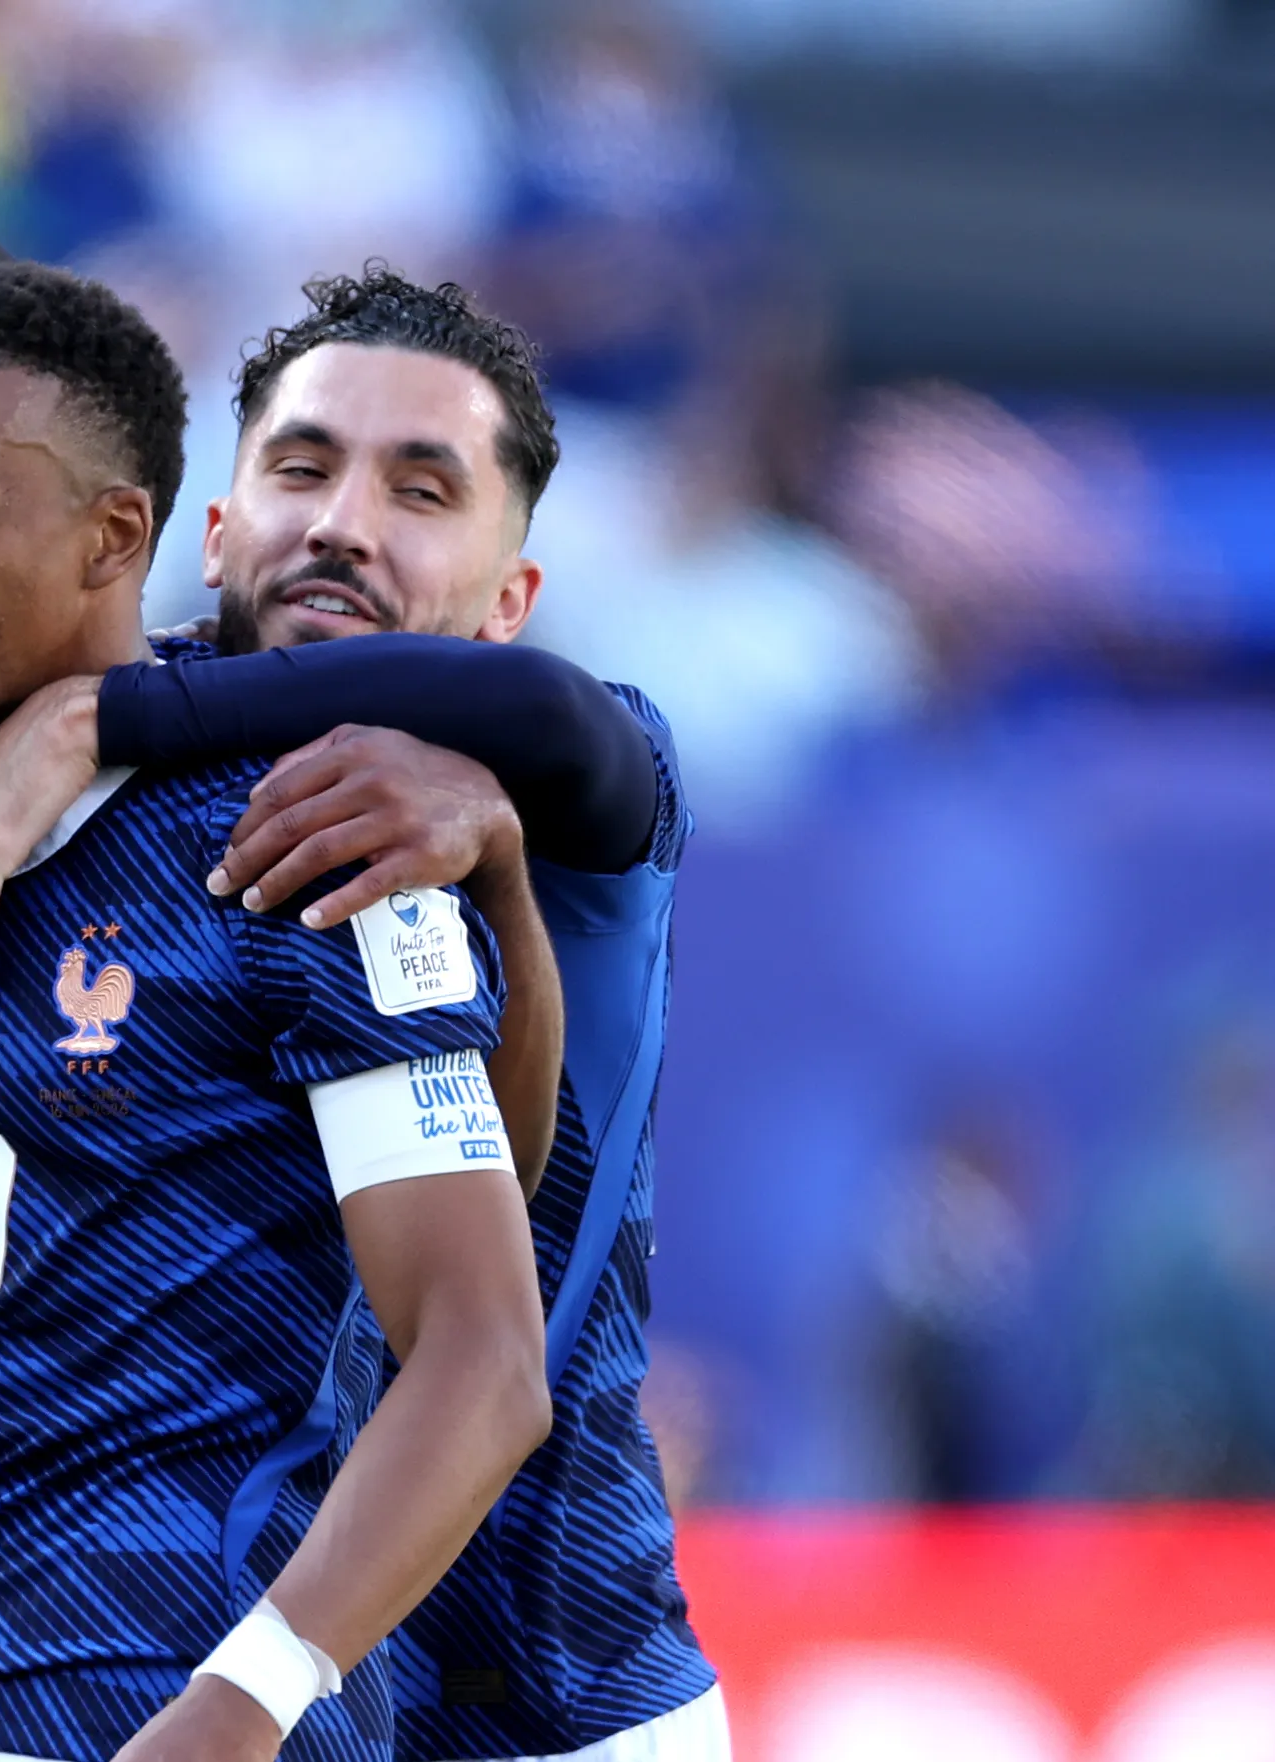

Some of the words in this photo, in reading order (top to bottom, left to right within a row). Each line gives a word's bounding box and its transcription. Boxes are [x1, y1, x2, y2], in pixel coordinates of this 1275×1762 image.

[391, 933, 425, 957] Unite
[426, 926, 445, 948] For
[400, 951, 449, 979] PEACE
[416, 978, 443, 992] FIFA
[408, 1050, 485, 1077] FOOTBAL
[414, 1112, 459, 1139] the
[460, 1109, 506, 1134] Worl
[464, 1142, 500, 1157] FIFA
